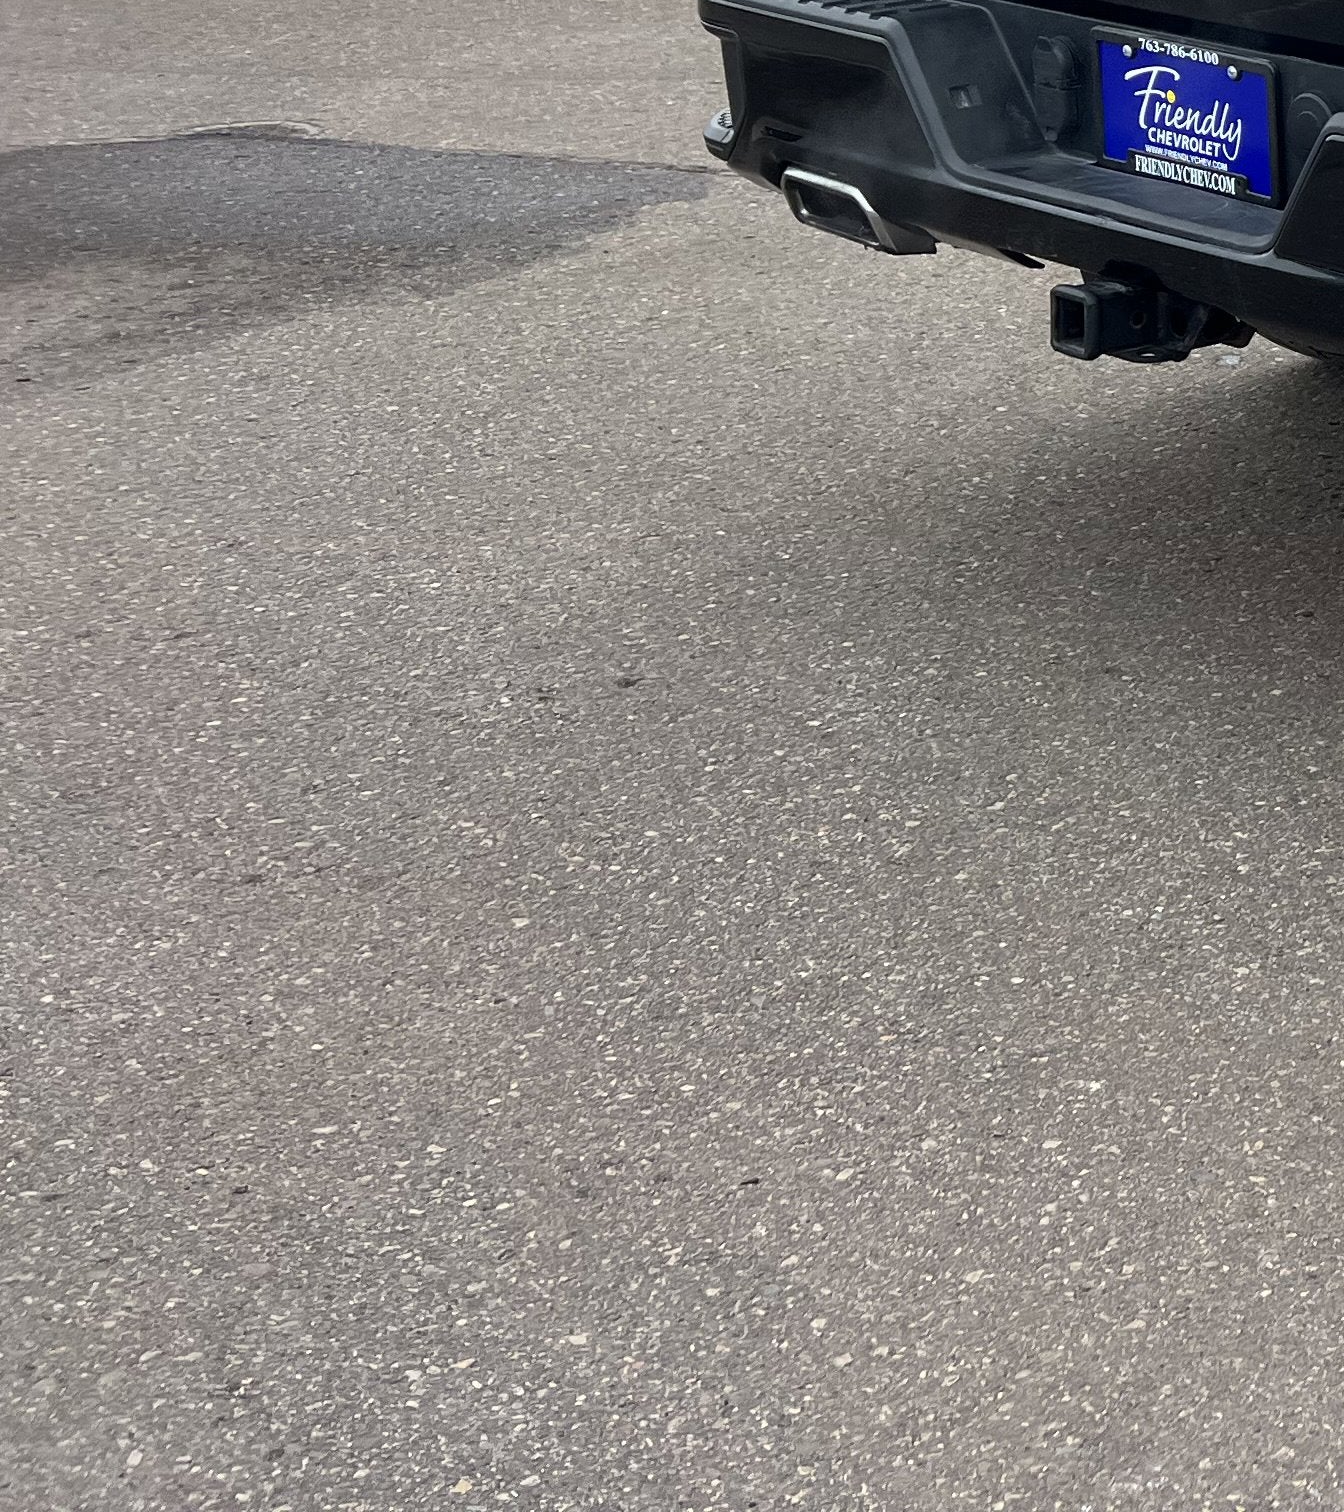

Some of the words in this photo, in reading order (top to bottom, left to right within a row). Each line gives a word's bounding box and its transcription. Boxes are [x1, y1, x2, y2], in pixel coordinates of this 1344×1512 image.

[1138, 38, 1220, 65] 763-786-6100
[1124, 65, 1242, 161] Friendly
[1148, 127, 1221, 158] CHEVROLET
[1135, 154, 1236, 195] FRIENDLYCHEV.COM
